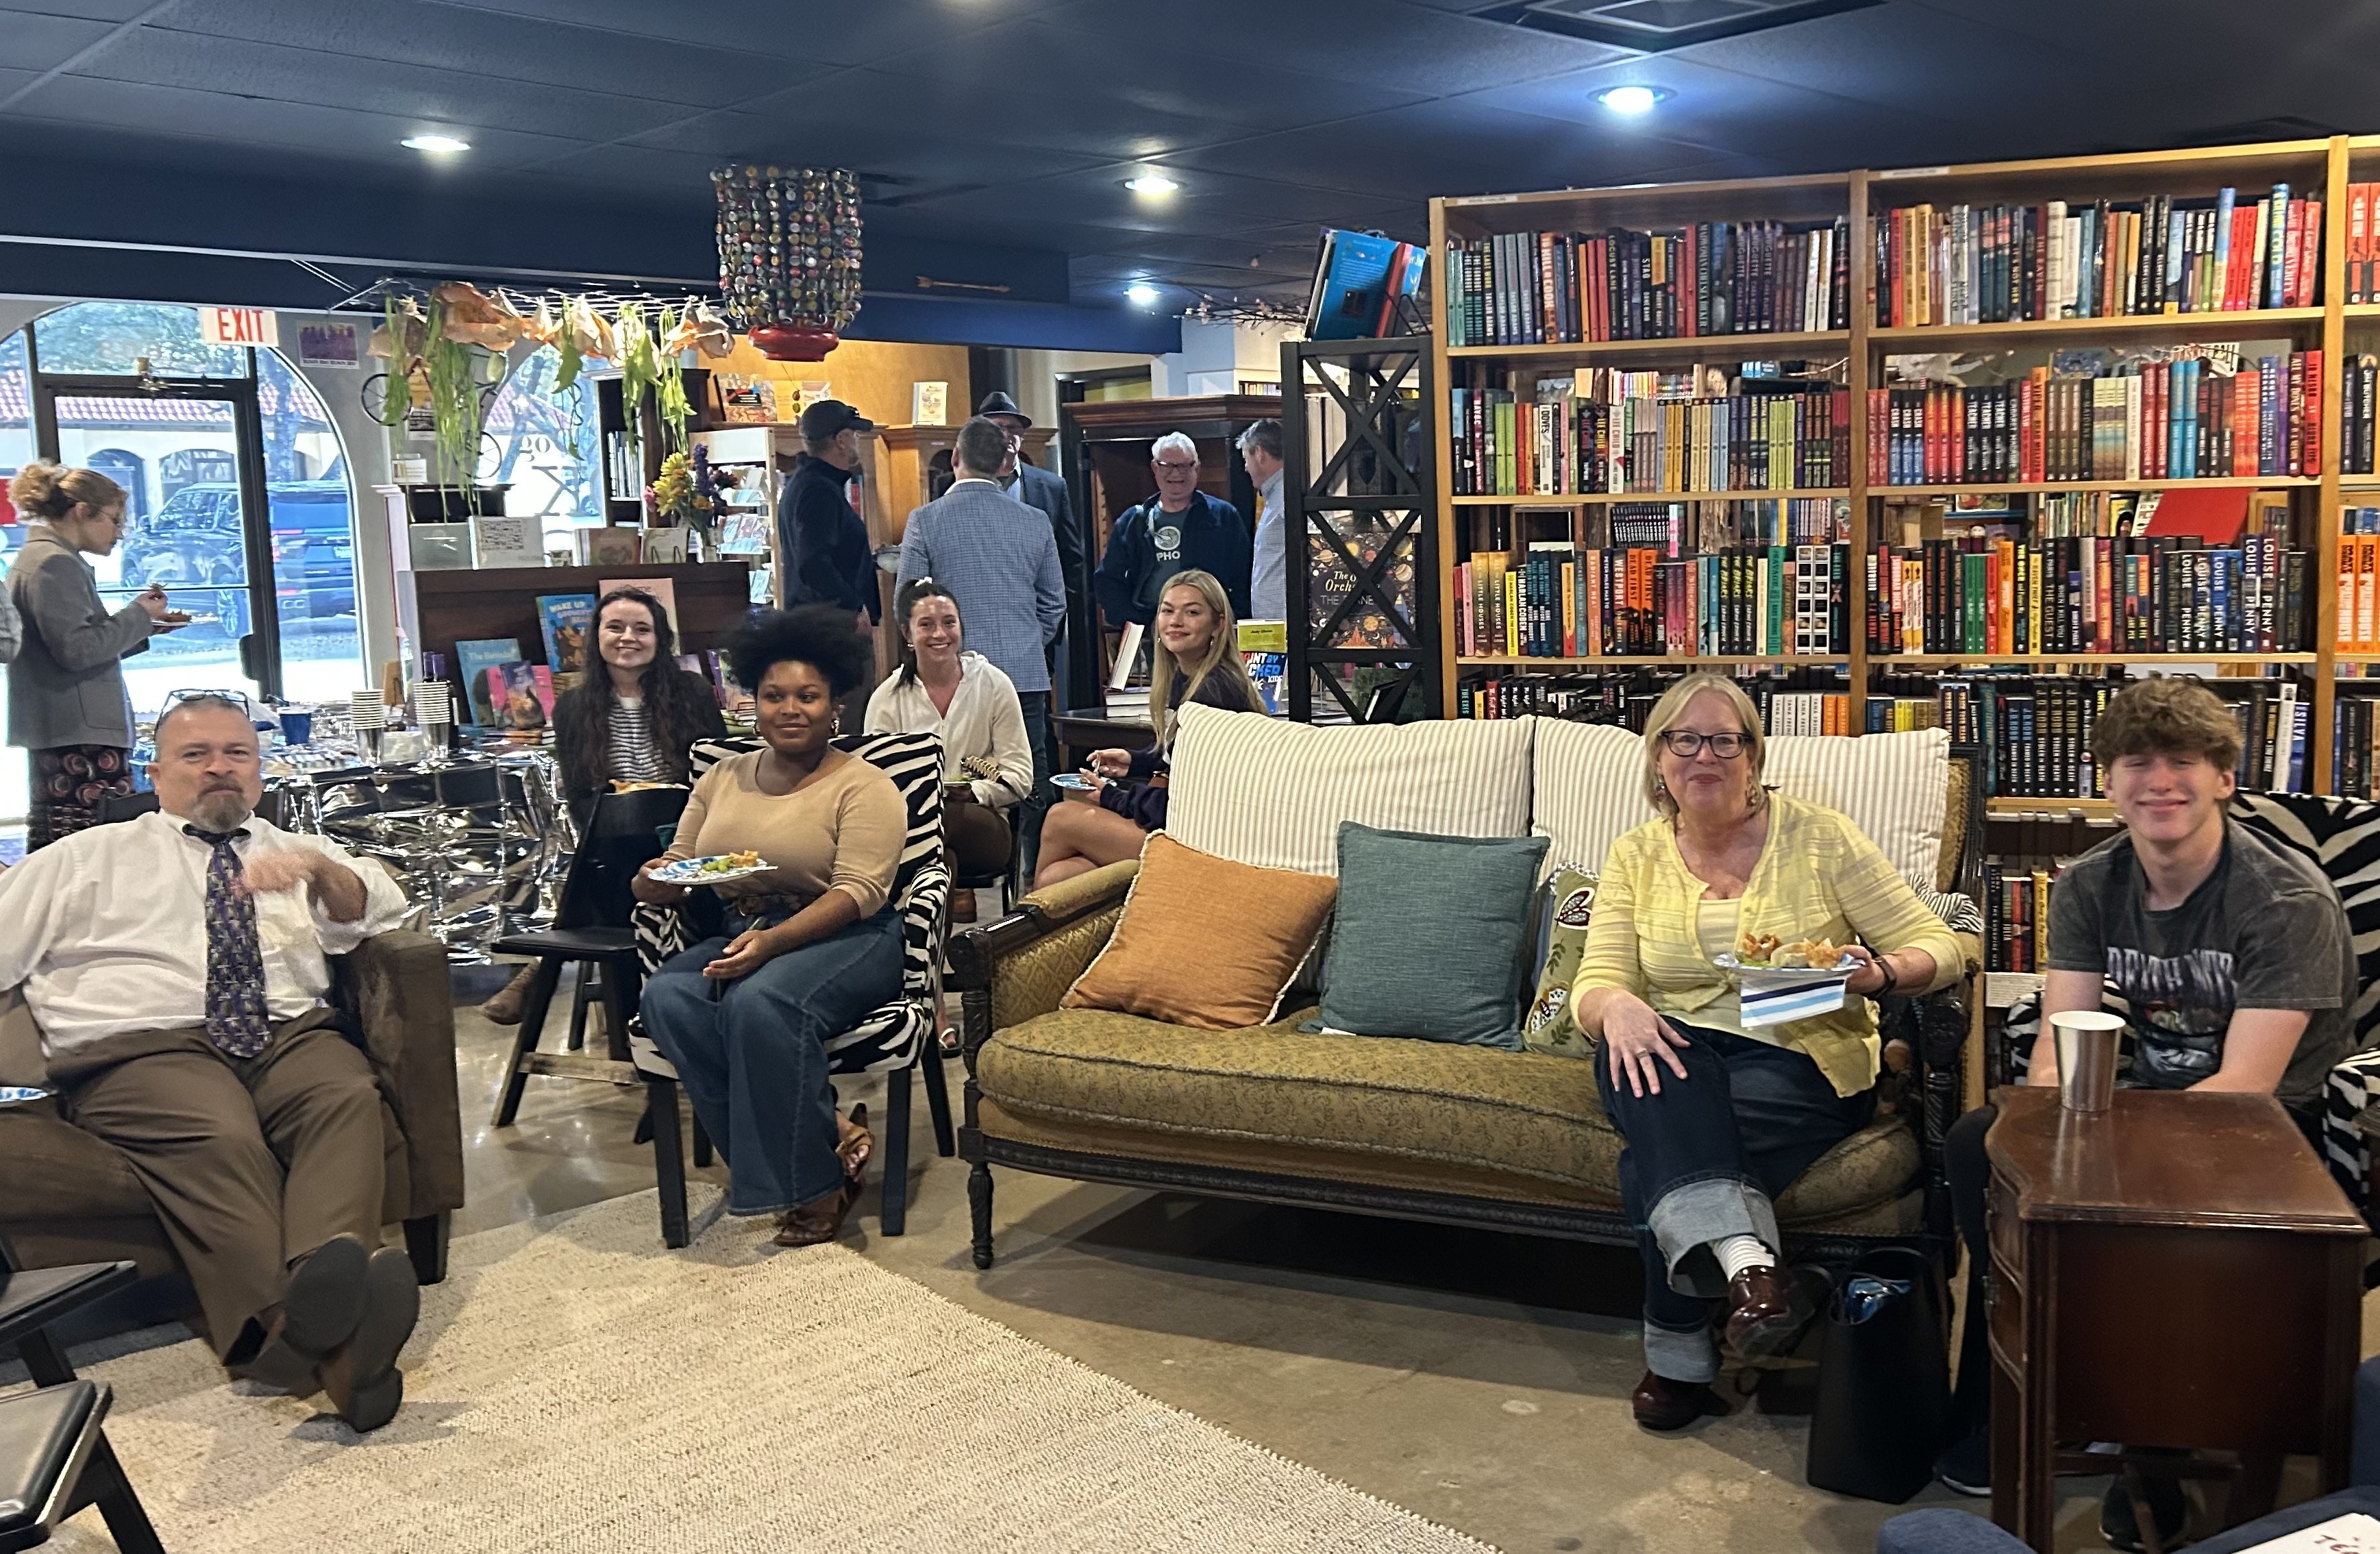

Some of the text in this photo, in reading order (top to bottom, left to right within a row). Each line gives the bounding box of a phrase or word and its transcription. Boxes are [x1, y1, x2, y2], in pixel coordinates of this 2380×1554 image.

[1545, 279, 1554, 308] COOK
[216, 308, 263, 343] EXIT
[2033, 384, 2042, 410] VIPER
[1541, 410, 1550, 434] DOVES
[1968, 400, 1978, 429] TEACHER
[1981, 401, 1992, 430] TEACHER
[1994, 400, 2005, 428] TEACHER
[1611, 418, 1620, 449] LEE CHILD
[1156, 550, 1180, 562] PHO
[1334, 571, 1348, 580] The
[1614, 559, 1624, 606] WESTPORT
[2244, 539, 2257, 633] LOUISE PENNY
[2261, 538, 2274, 633] LOUISE PENNY
[1320, 595, 1340, 606] THE
[1517, 578, 1528, 631] HARLAN COBEN
[2044, 583, 2054, 604] THE
[2181, 554, 2191, 640] LOUISE PENNY
[2196, 557, 2207, 639] LOUISE PENNY
[2214, 556, 2223, 638] LOUISE PENNY
[2044, 606, 2053, 638] GUEST
[2096, 690, 2105, 712] UNTIL
[2292, 712, 2307, 741] SILVA
[2053, 737, 2061, 757] STOLEN
[2067, 737, 2076, 757] STOLEN
[2053, 765, 2061, 782] DEATH
[2067, 765, 2076, 782] DEATH
[2003, 924, 2012, 941] JULIA
